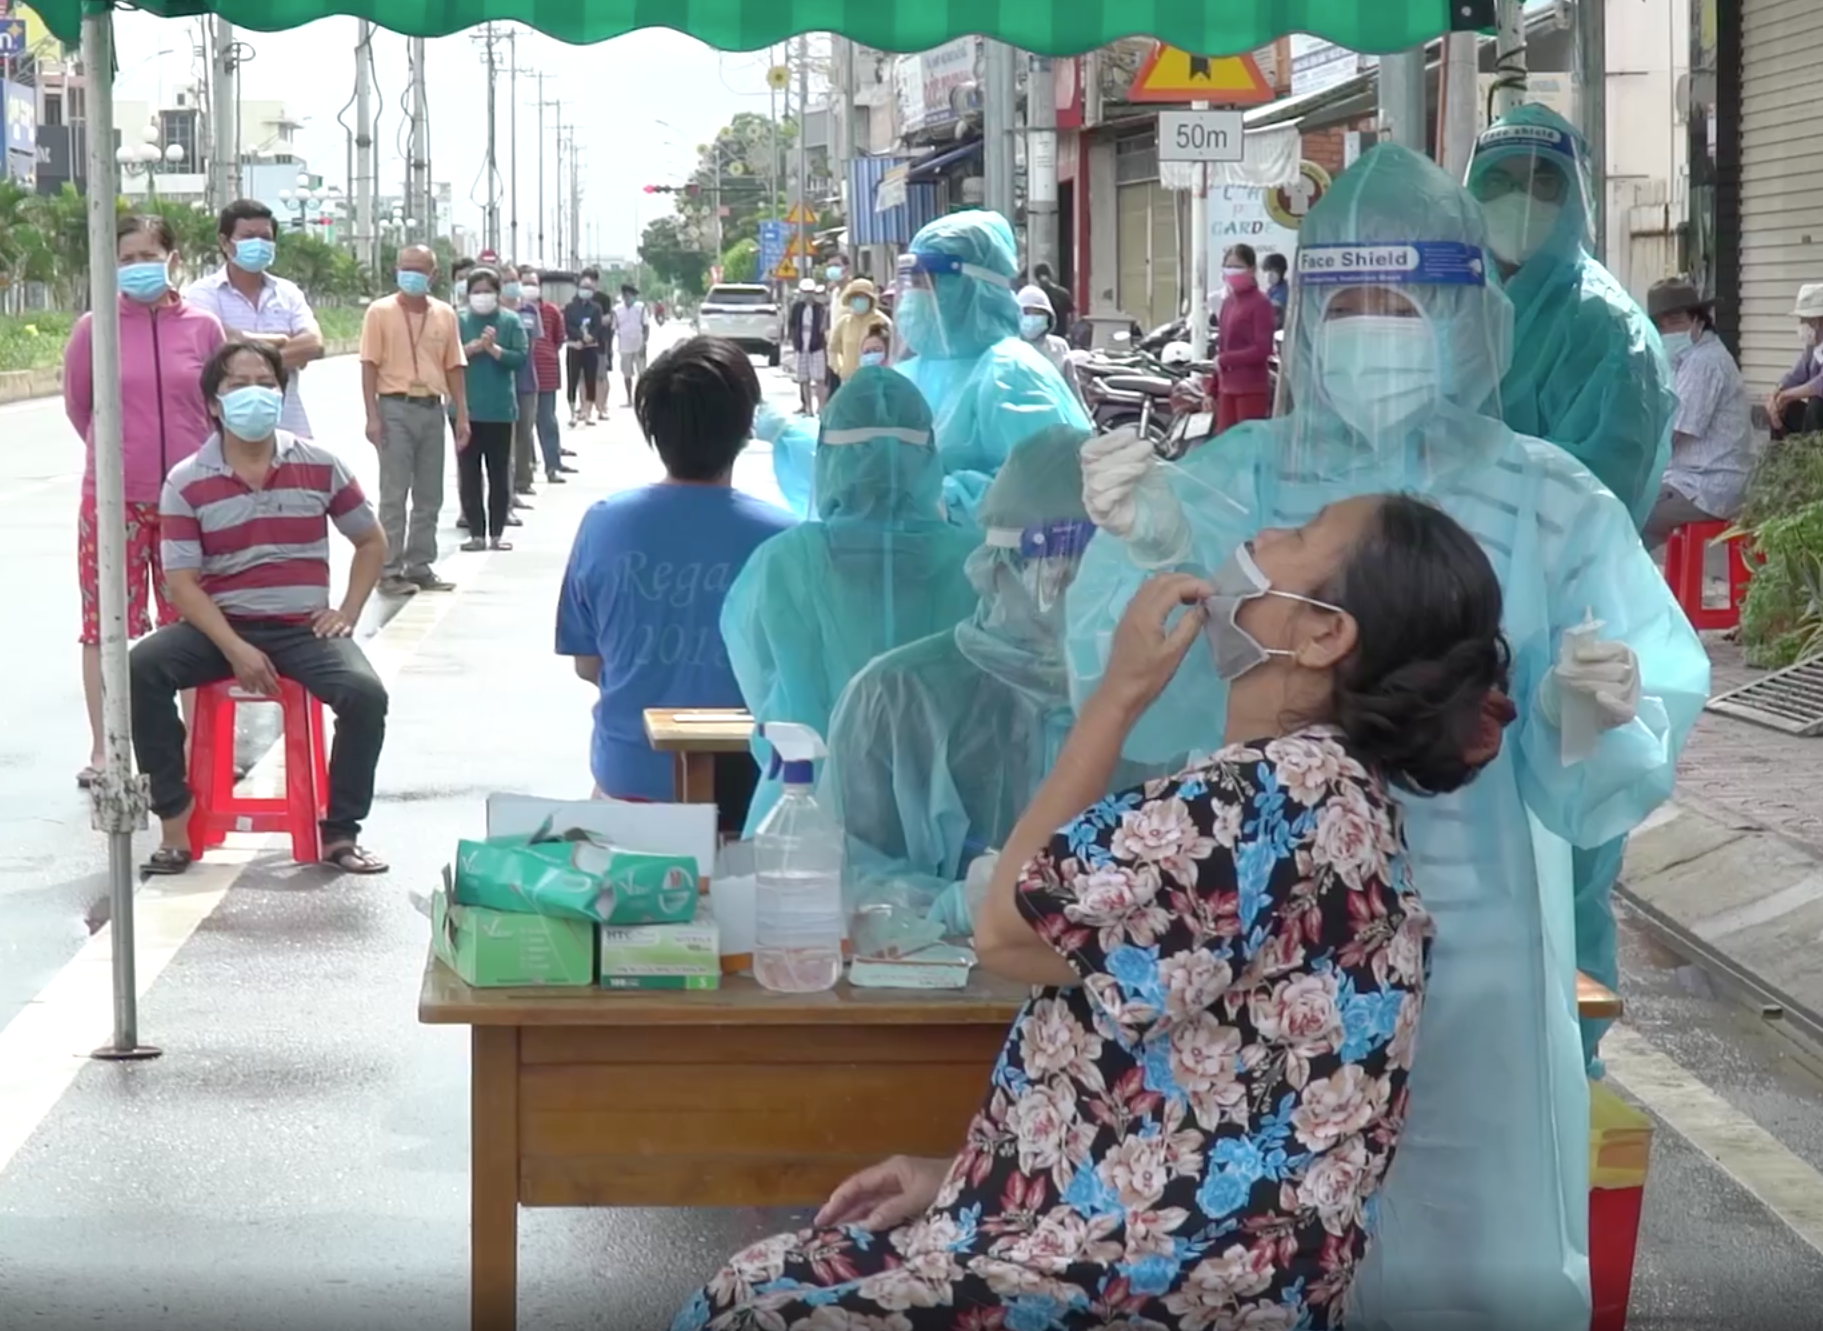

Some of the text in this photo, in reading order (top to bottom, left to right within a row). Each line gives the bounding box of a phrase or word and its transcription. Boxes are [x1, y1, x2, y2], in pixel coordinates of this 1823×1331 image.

[1176, 123, 1228, 149] 50m
[1301, 253, 1335, 270] Face
[1341, 251, 1408, 267] Shield
